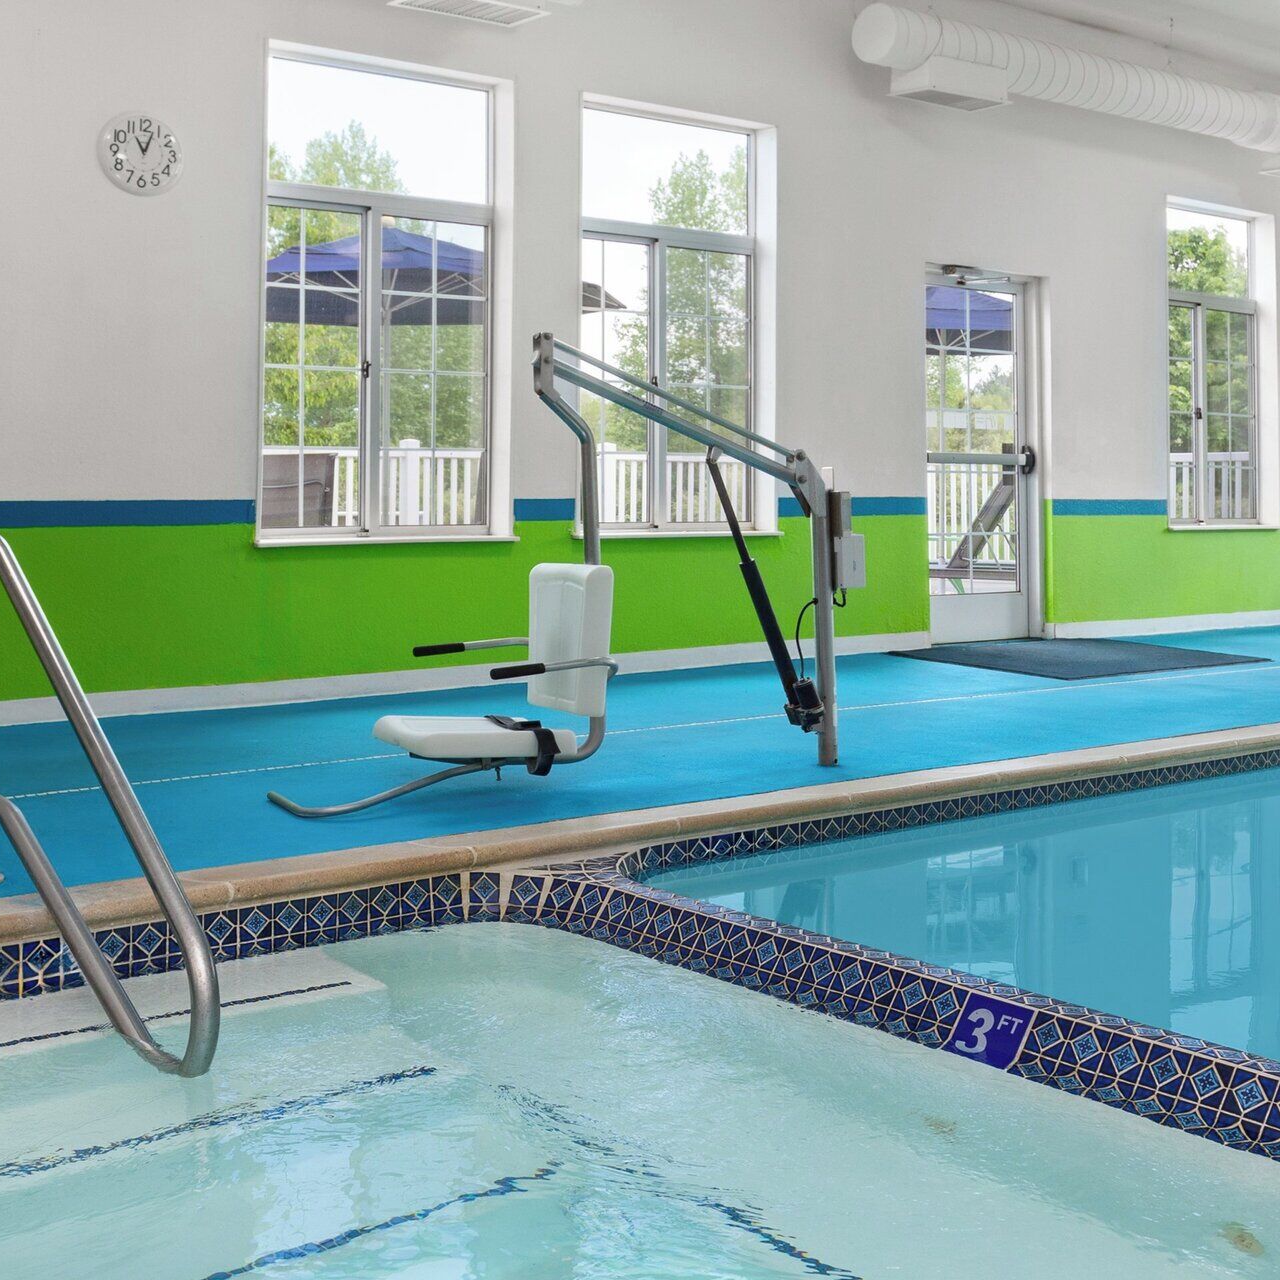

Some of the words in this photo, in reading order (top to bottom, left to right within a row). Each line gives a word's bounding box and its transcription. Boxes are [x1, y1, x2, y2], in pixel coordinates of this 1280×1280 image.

[127, 120, 135, 134] 11
[140, 118, 152, 133] 12
[114, 128, 127, 144] 10
[163, 134, 173, 148] 2
[109, 143, 119, 157] 9
[167, 149, 177, 164] 3
[114, 157, 123, 171] 8
[161, 164, 170, 177] 4
[126, 169, 134, 183] 7
[136, 174, 147, 188] 6
[150, 172, 160, 186] 5
[954, 1008, 995, 1054] 3
[996, 1014, 1023, 1034] FT
